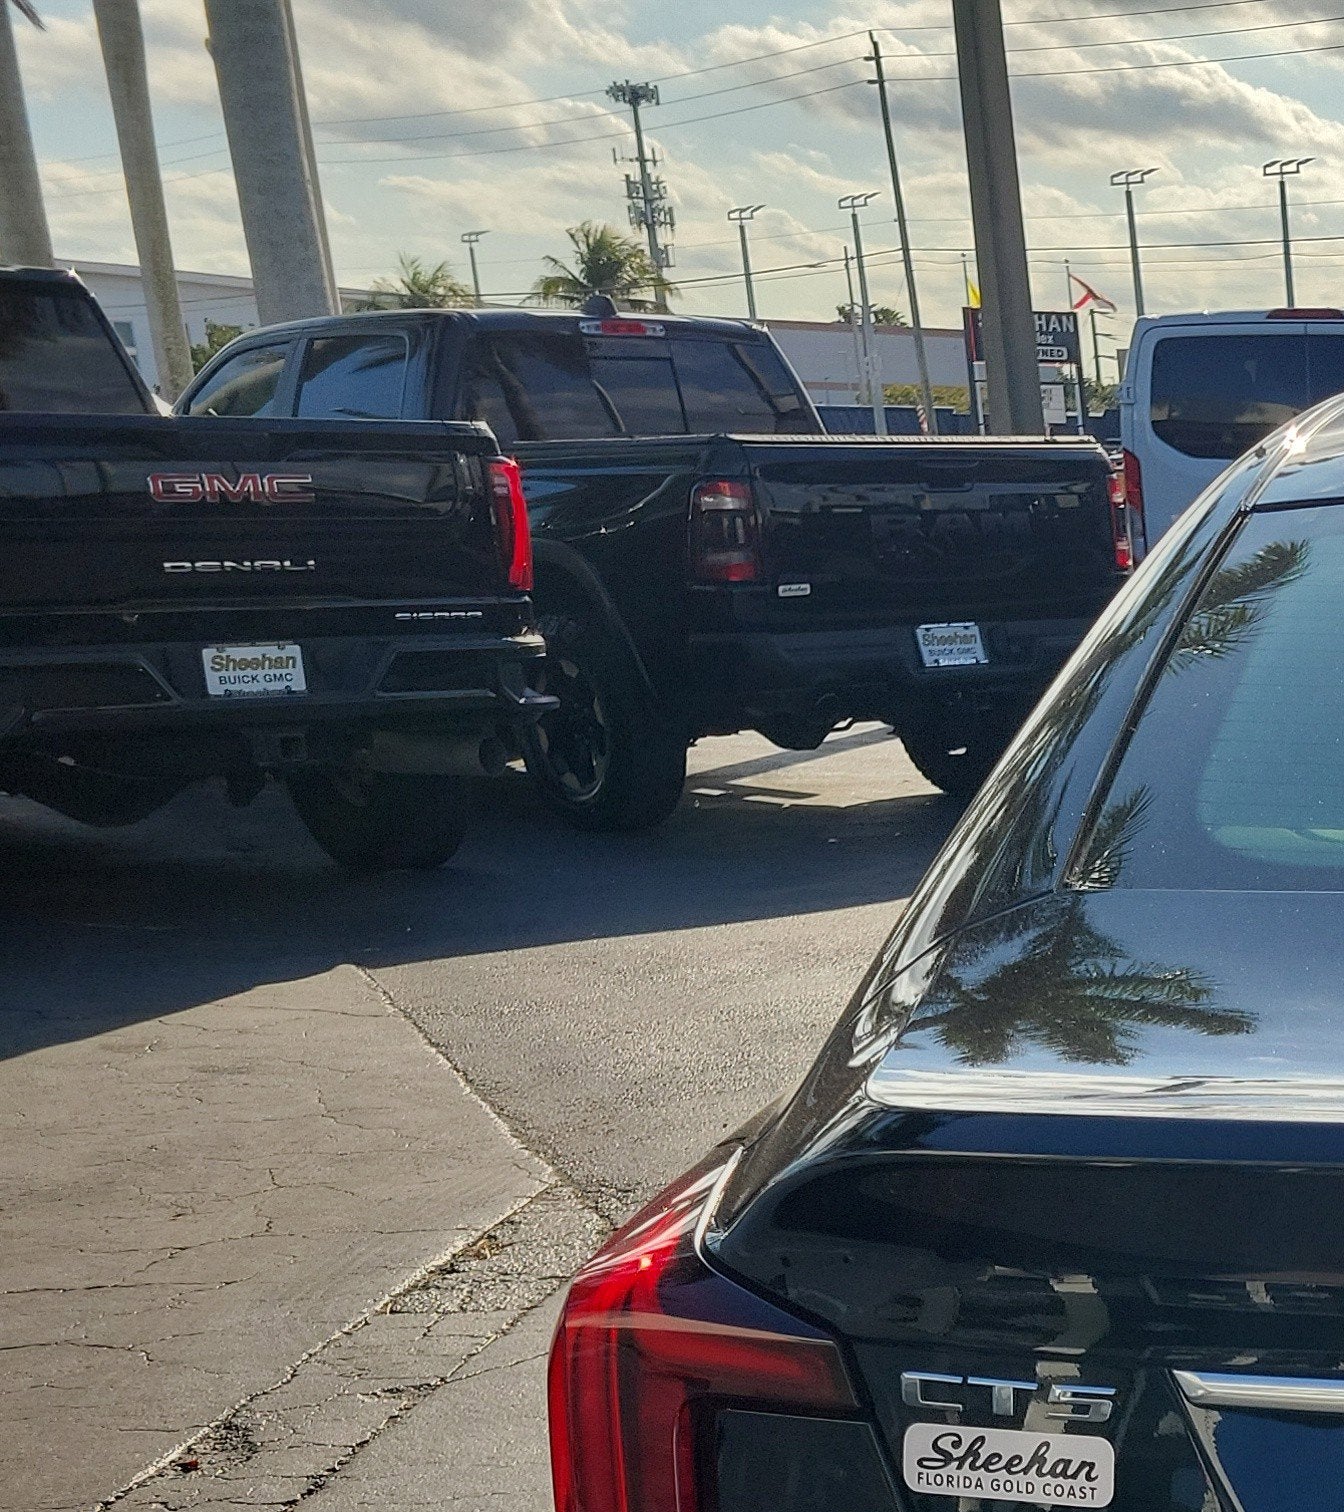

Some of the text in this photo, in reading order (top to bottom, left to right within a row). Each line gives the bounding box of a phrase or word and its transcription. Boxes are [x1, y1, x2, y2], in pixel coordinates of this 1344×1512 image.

[148, 472, 315, 504] GMC
[163, 560, 315, 573] DENALI
[210, 653, 297, 672] Sheehan
[218, 672, 294, 685] BUICK GMC
[916, 1431, 1099, 1483] Sheehan
[917, 1471, 1098, 1501] FLORIDA GOLD COAST
